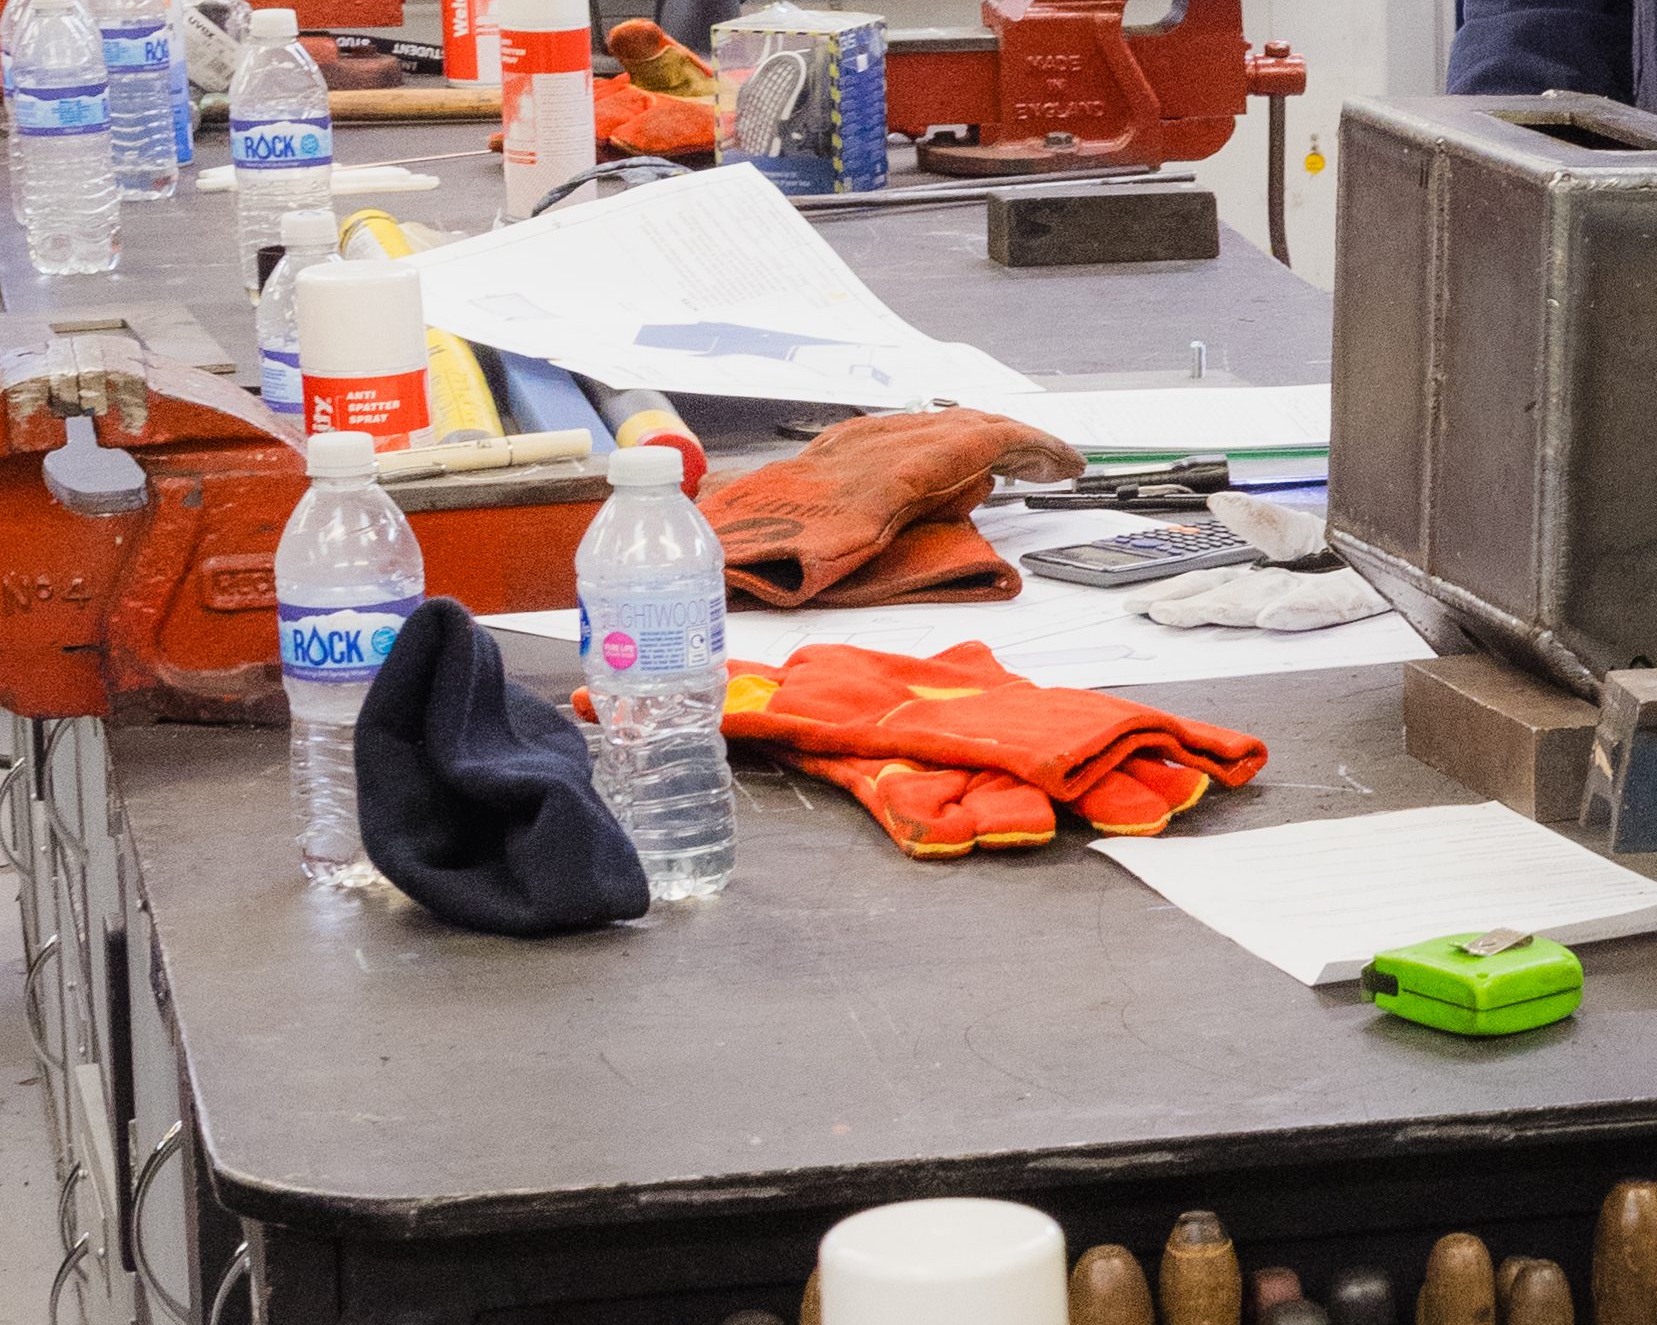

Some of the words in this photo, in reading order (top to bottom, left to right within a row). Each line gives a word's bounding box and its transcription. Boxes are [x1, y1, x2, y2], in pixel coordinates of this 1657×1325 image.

[391, 40, 443, 61] TUDENT
[244, 132, 296, 159] ROCK
[346, 390, 377, 401] ANTI
[348, 399, 400, 413] SPATTER
[348, 413, 388, 425] SPRAY
[292, 625, 365, 667] ROCK
